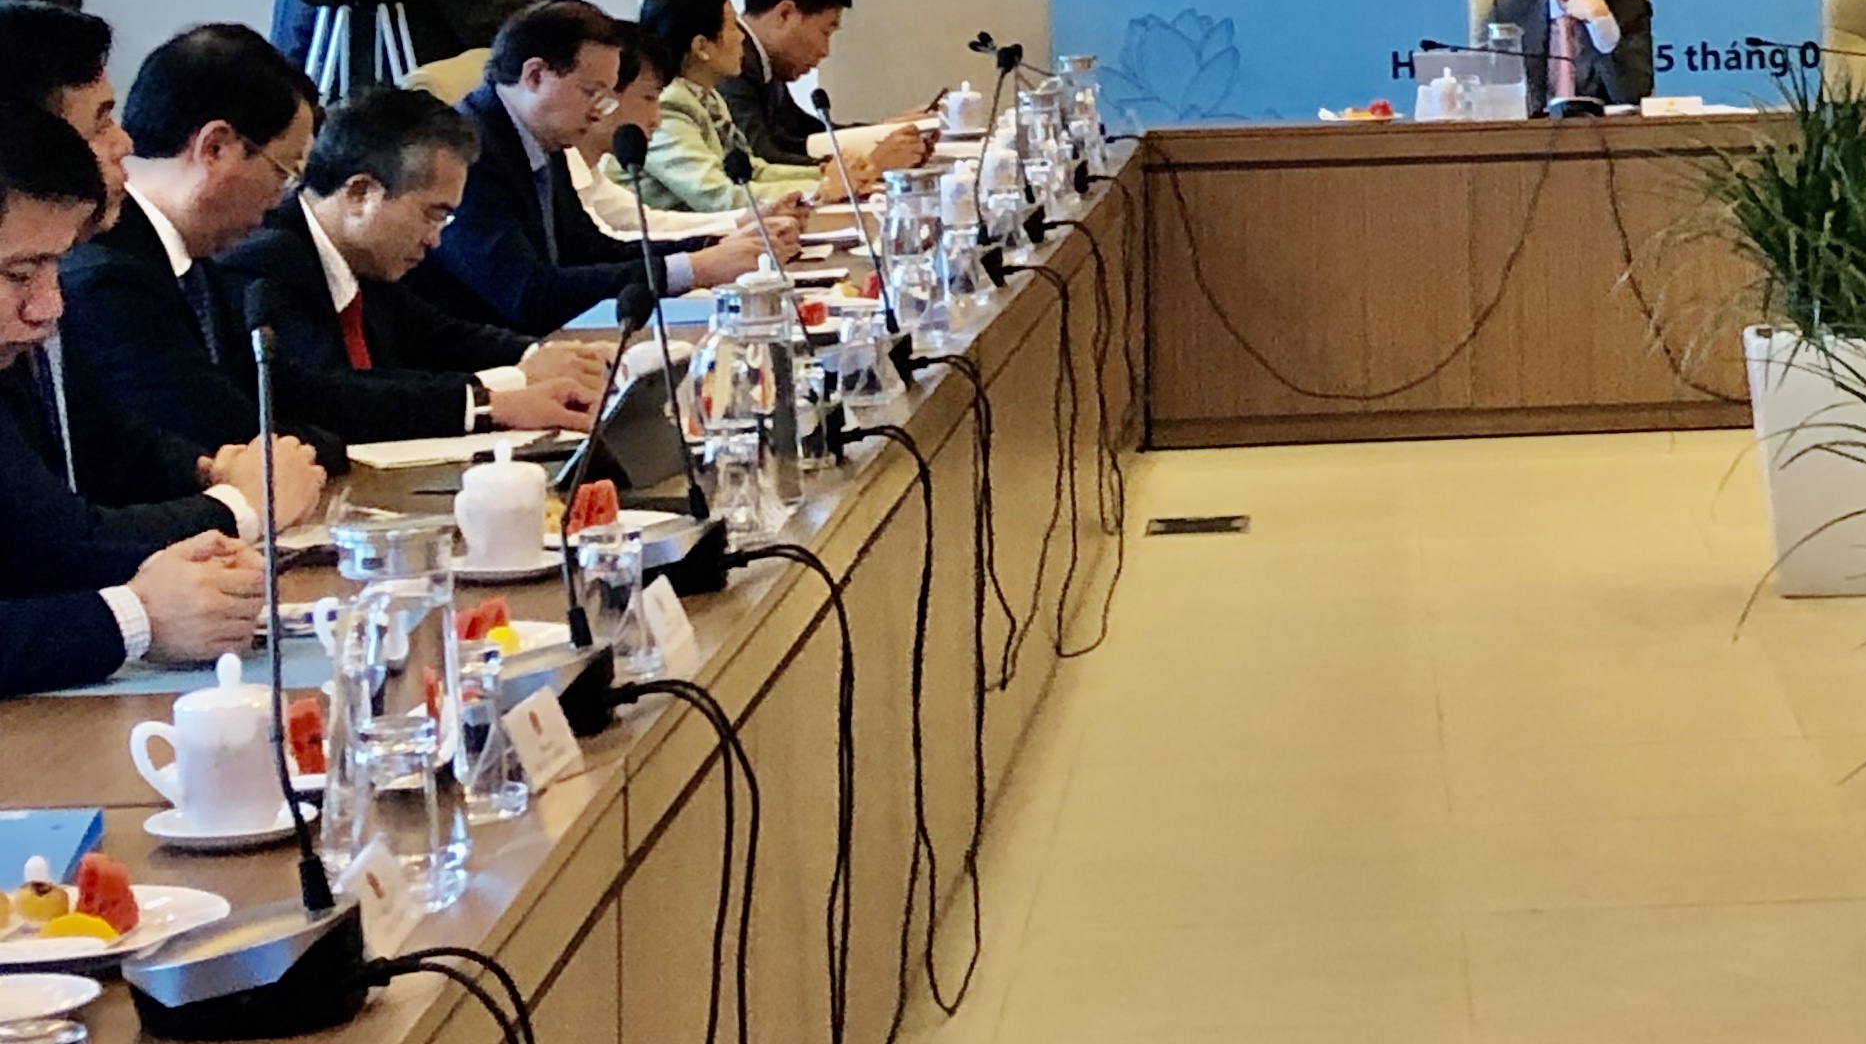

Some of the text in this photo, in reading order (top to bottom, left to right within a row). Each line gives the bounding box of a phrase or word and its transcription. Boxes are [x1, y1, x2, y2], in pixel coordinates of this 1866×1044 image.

[1391, 51, 1414, 79] H
[1656, 44, 1674, 72] 5
[1683, 41, 1789, 77] tháng
[1801, 41, 1820, 68] 0
